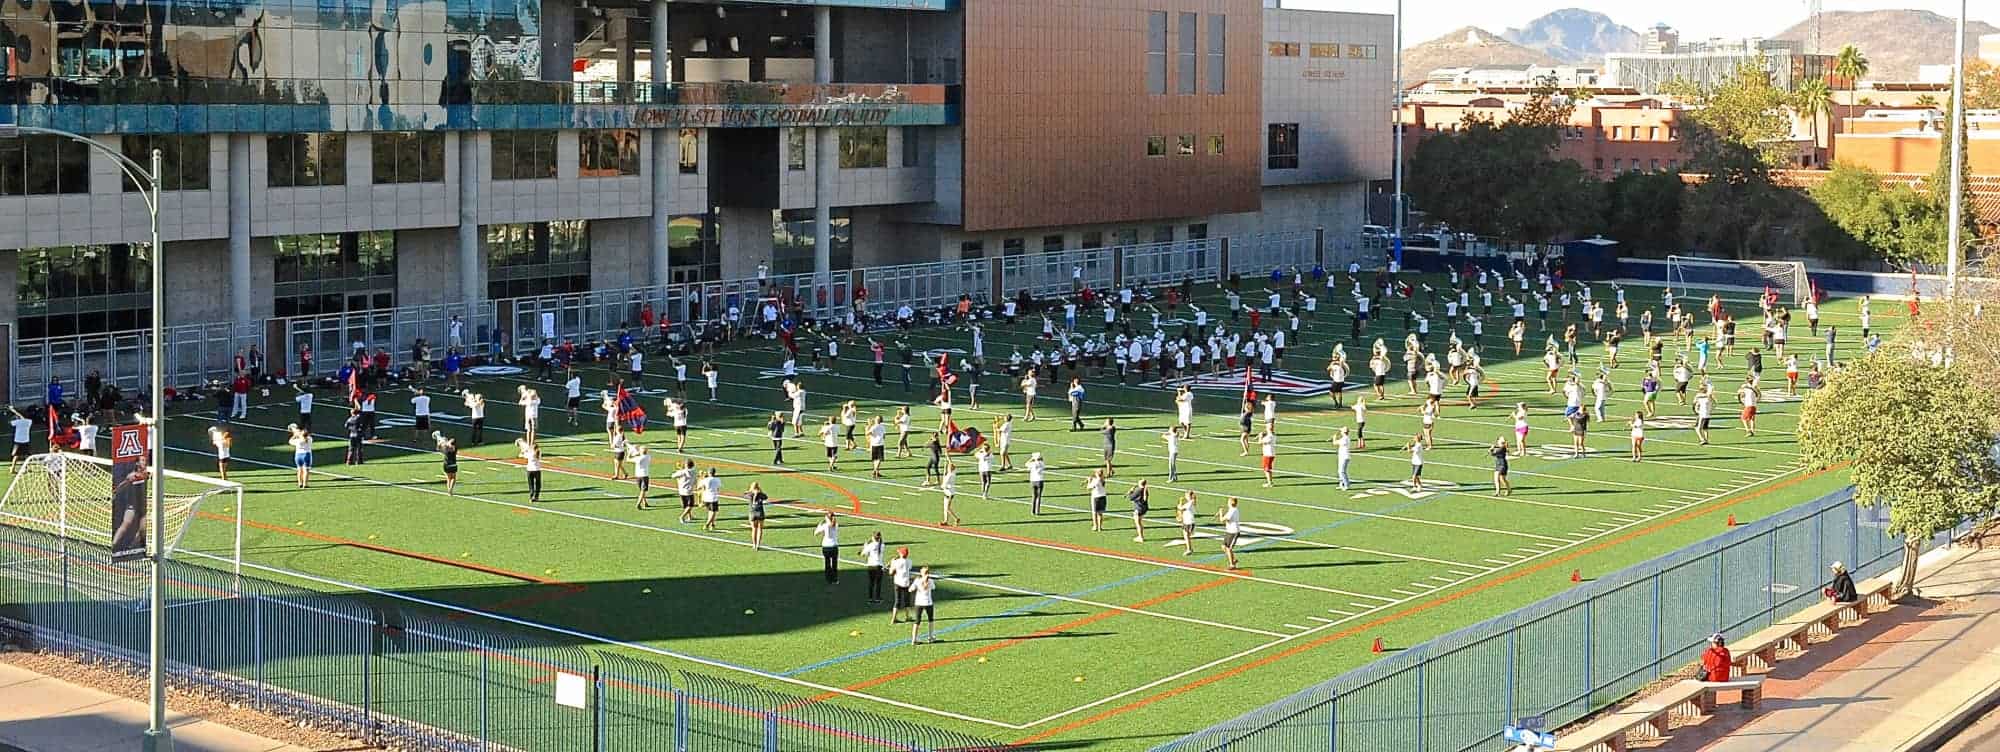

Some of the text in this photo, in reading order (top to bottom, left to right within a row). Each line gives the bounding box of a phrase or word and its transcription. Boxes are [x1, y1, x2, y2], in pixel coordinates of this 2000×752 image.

[761, 108, 830, 123] FOOTBALL
[832, 107, 891, 122] FACILITY
[117, 430, 143, 458] A
